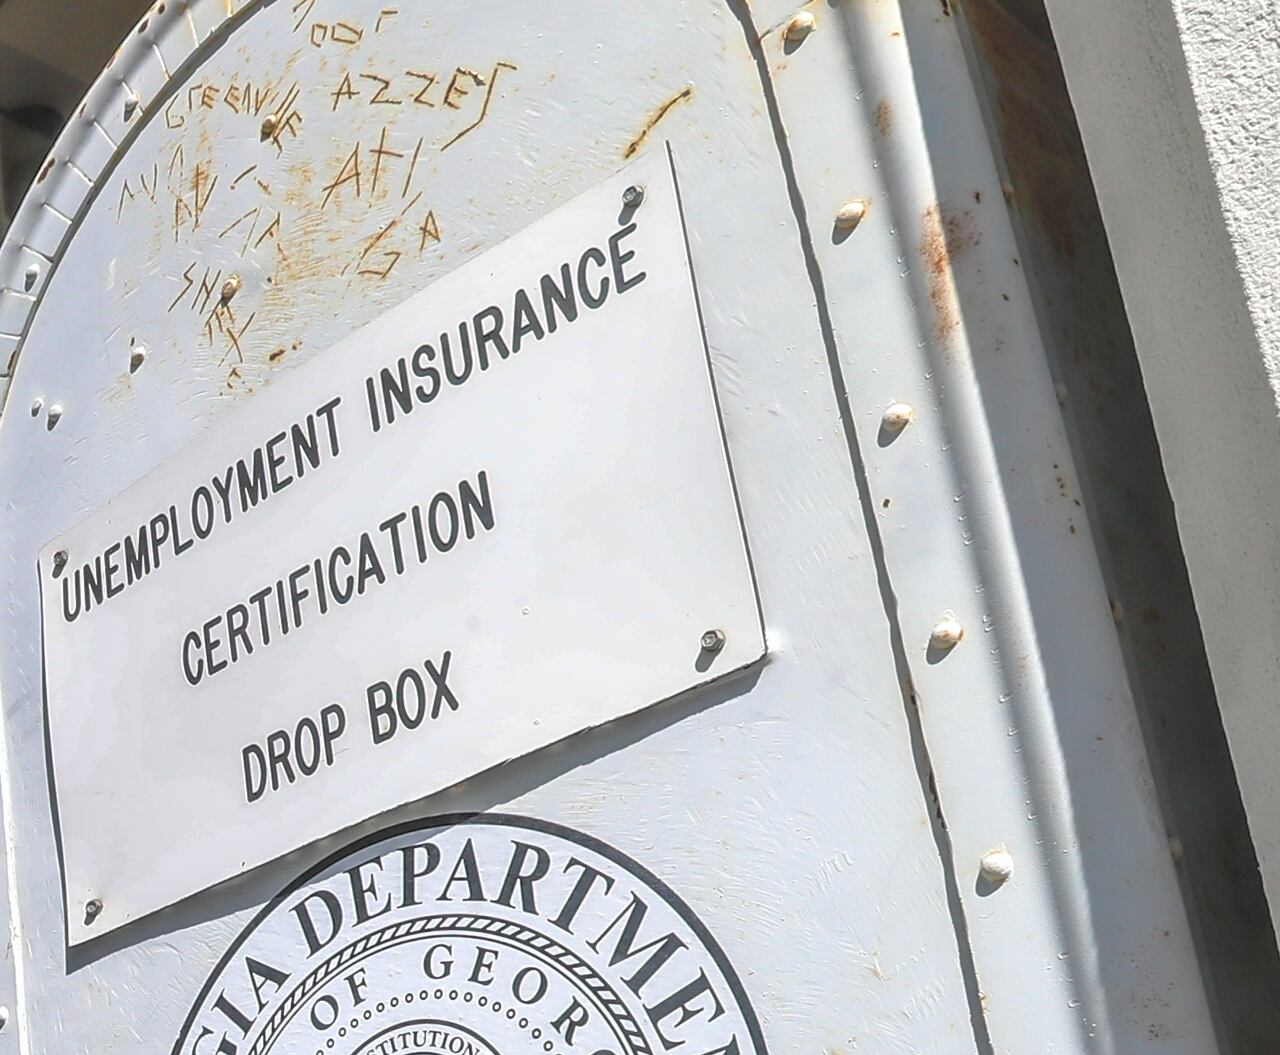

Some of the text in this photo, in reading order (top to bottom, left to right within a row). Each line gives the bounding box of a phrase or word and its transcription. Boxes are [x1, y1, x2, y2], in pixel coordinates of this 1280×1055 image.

[61, 397, 343, 621] UNEMPLOYMENT
[365, 223, 647, 433] INSURANCE
[181, 471, 496, 687] CERTIFICATION
[242, 651, 460, 803] DROP BOX
[310, 968, 369, 1031] OF
